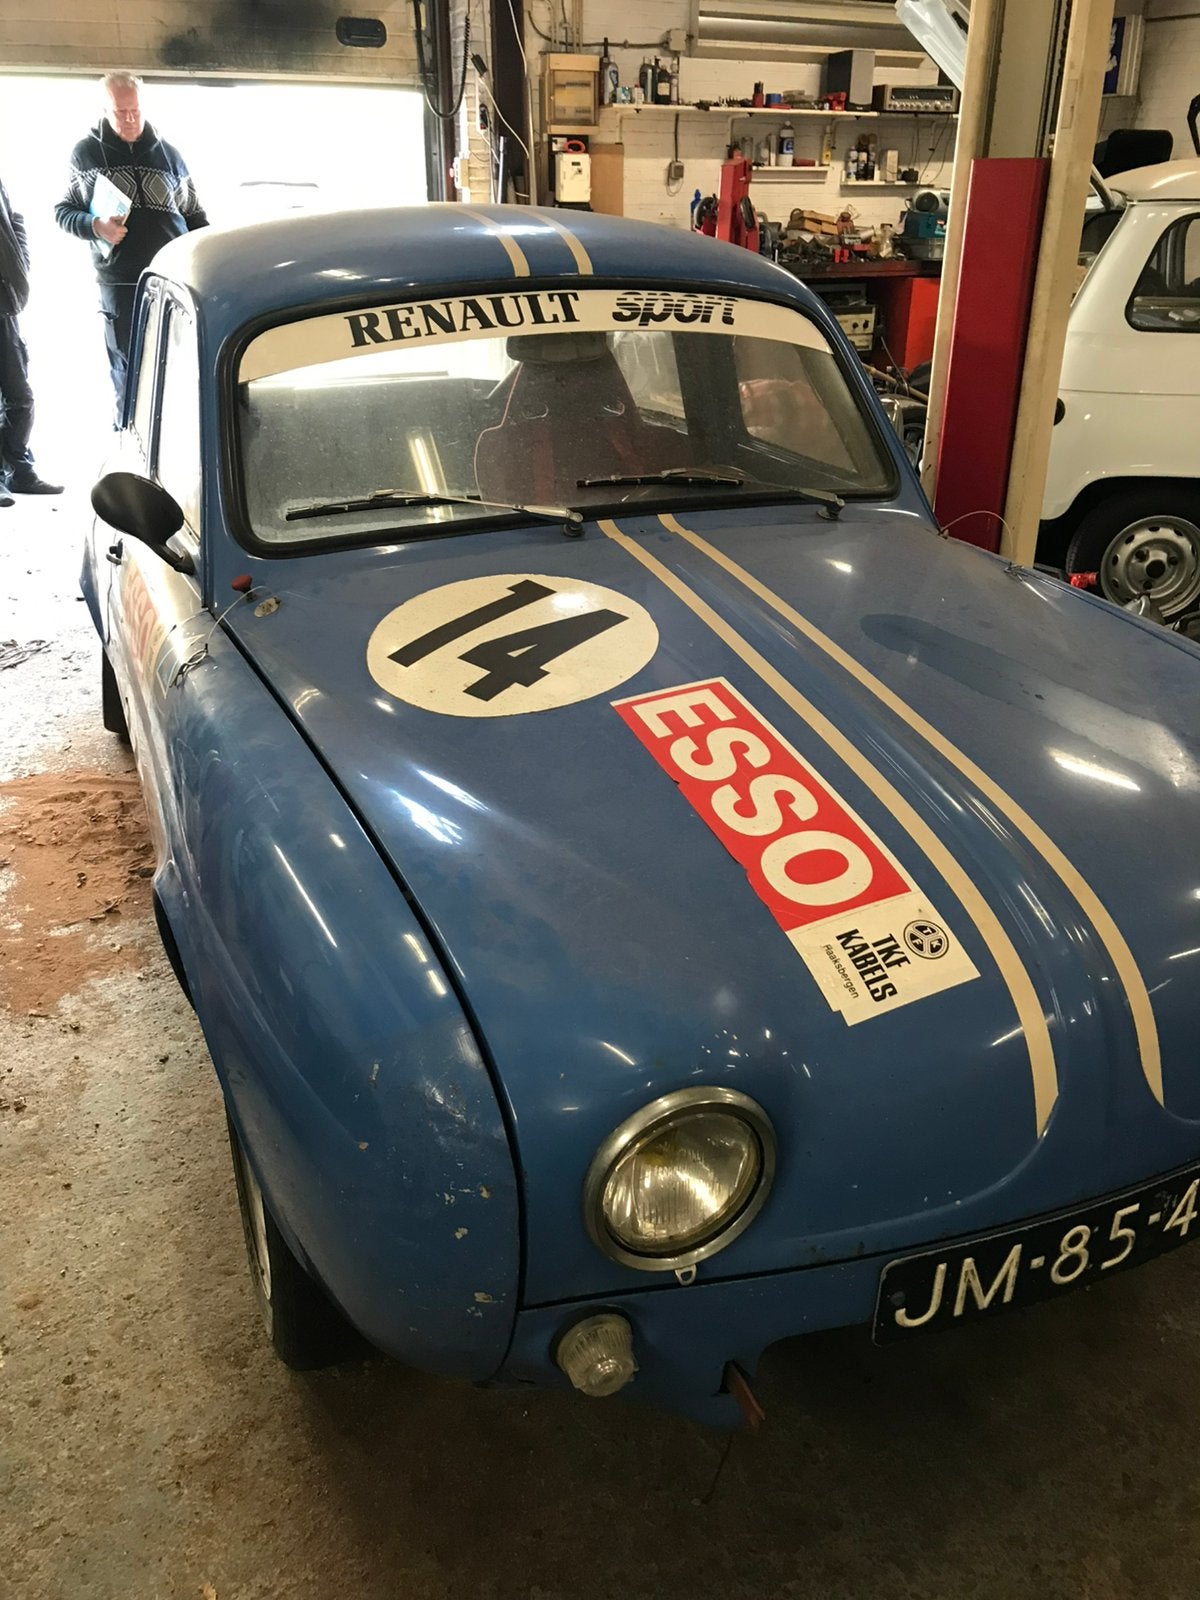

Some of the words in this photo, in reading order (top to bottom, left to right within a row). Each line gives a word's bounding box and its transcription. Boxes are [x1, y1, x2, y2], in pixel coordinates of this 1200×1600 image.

[343, 291, 580, 348] RENAULT
[612, 291, 738, 327] sport
[387, 579, 630, 702] 14
[631, 688, 874, 907] ESSO
[822, 943, 860, 1000] Haaksbergen
[835, 928, 898, 1003] KABELS
[871, 933, 912, 969] TKF
